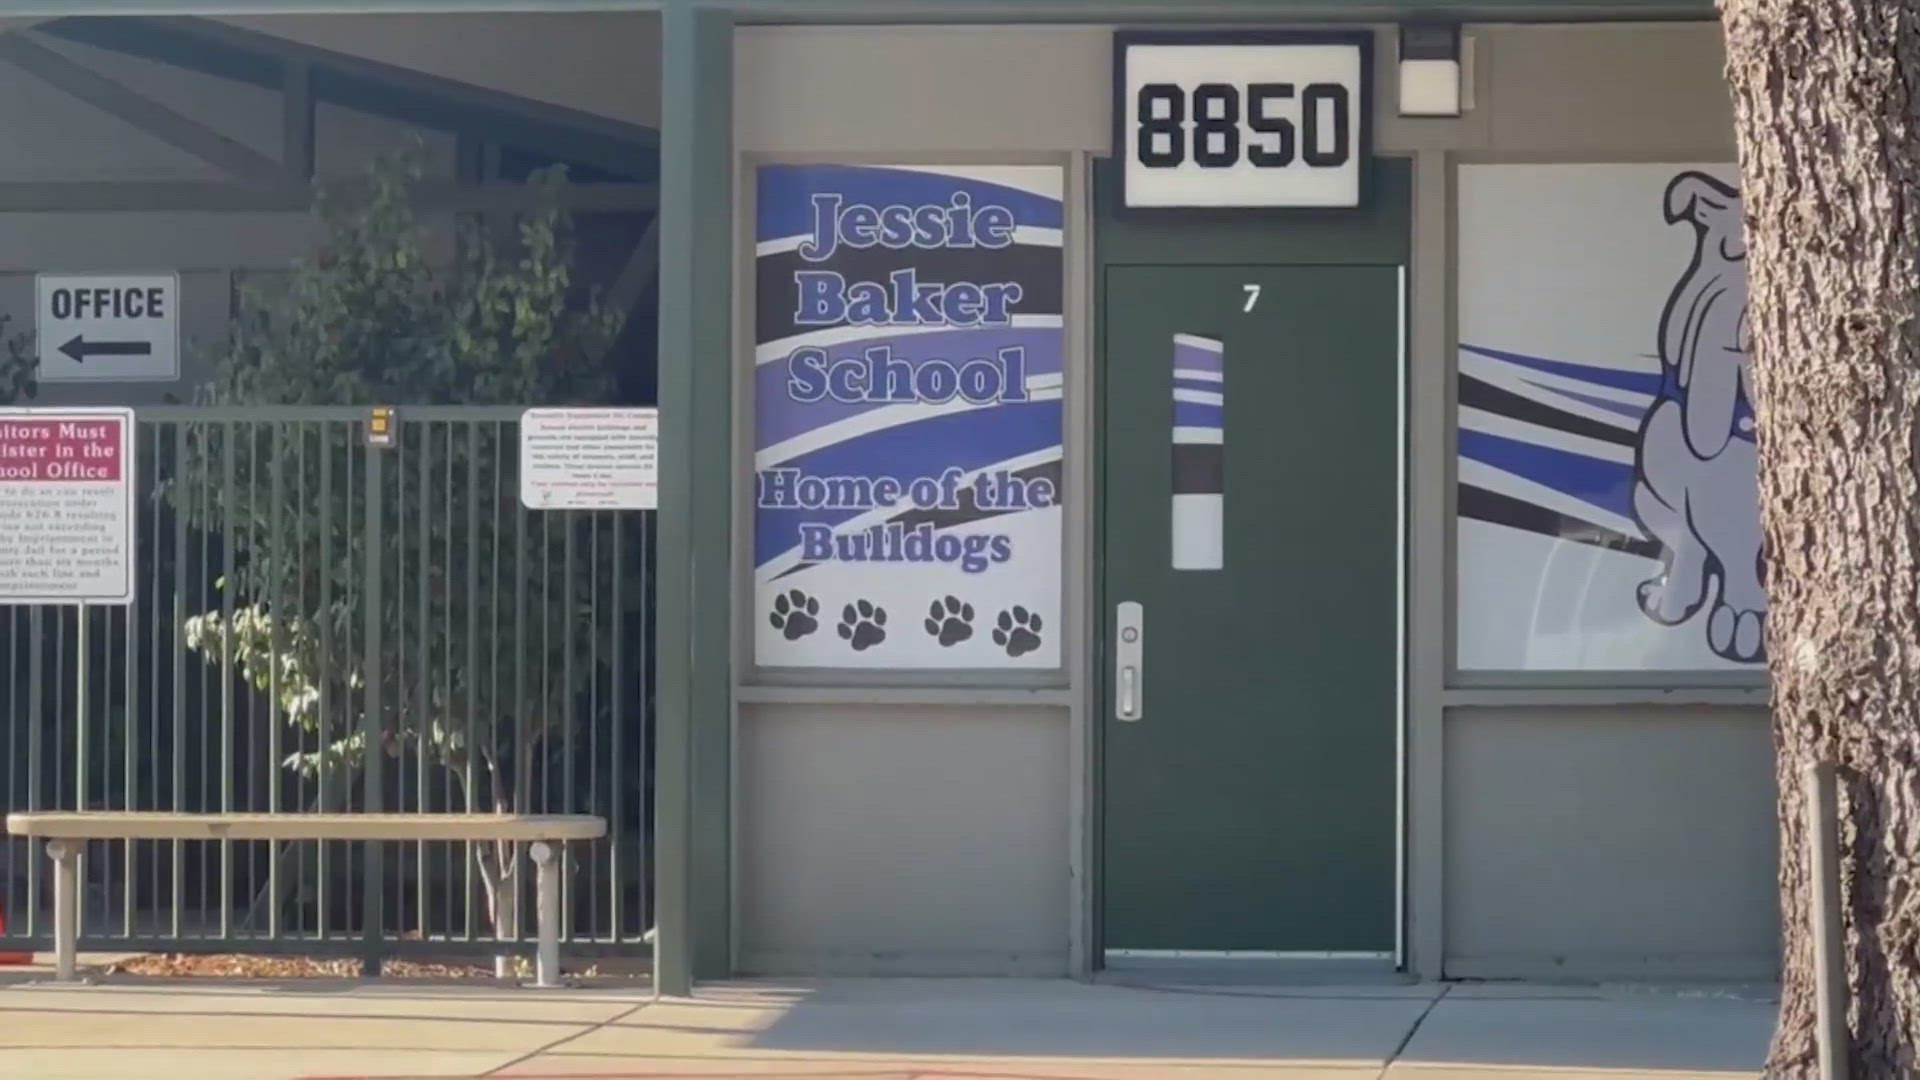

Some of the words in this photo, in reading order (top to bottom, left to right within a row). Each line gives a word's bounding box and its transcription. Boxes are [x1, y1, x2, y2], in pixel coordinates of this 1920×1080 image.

[1138, 83, 1349, 168] 8850
[799, 191, 1014, 262] Jessie
[51, 288, 164, 319] OFFICE
[794, 268, 1023, 327] Baker
[1243, 284, 1261, 313] 7
[788, 346, 1029, 403] School
[0, 423, 50, 439] itors
[58, 423, 107, 439] Must
[55, 443, 75, 458] in
[83, 442, 115, 457] the
[47, 461, 109, 478] Office
[758, 467, 901, 509] Home
[910, 466, 965, 509] of
[974, 470, 1056, 509] the
[799, 522, 1012, 574] Bulldogs
